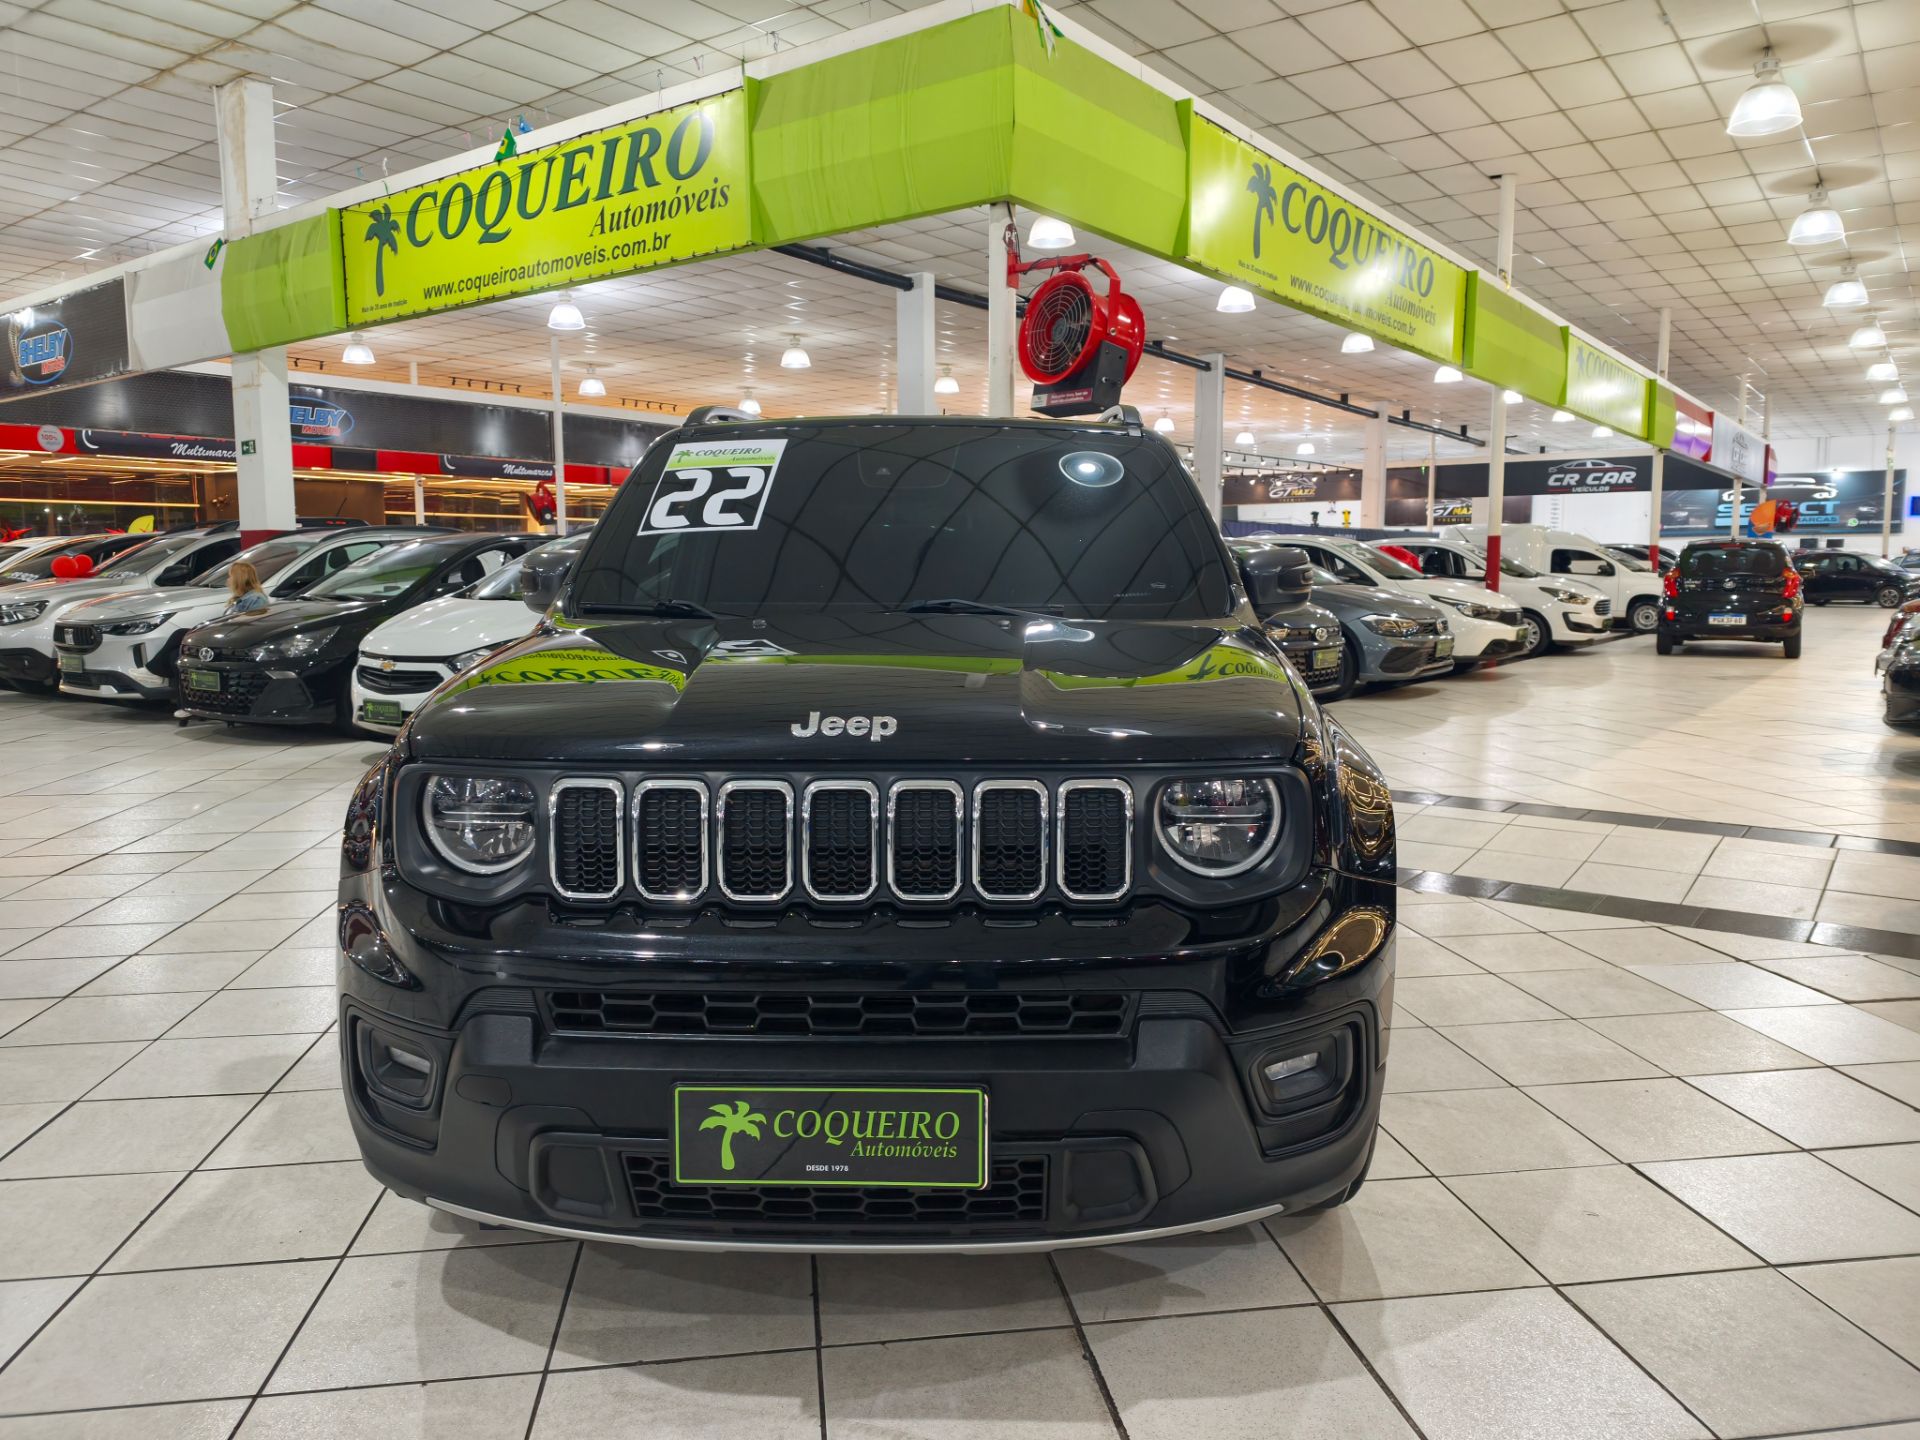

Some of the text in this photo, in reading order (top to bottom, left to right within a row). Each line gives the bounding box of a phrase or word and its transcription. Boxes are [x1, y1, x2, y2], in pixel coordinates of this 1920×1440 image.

[406, 111, 714, 248] COQUEIRO
[589, 177, 730, 237] Automóveis
[1281, 182, 1434, 298] COQUEIRO
[423, 231, 671, 300] www.coqueiroautomoveis.com.br
[1384, 290, 1437, 326] Automóveis
[19, 328, 68, 367] SHELBY
[289, 405, 347, 427] ELBY
[170, 442, 237, 459] Multimarca
[695, 447, 762, 458] COQUEIRO
[1547, 471, 1637, 487] CR CAR
[650, 466, 766, 529] 22
[1717, 500, 1841, 516] SECT
[791, 711, 897, 742] Jeep
[773, 1109, 960, 1146] COQUEIRO
[849, 1140, 958, 1158] Automóveis
[805, 1164, 849, 1172] DESDE 1978
